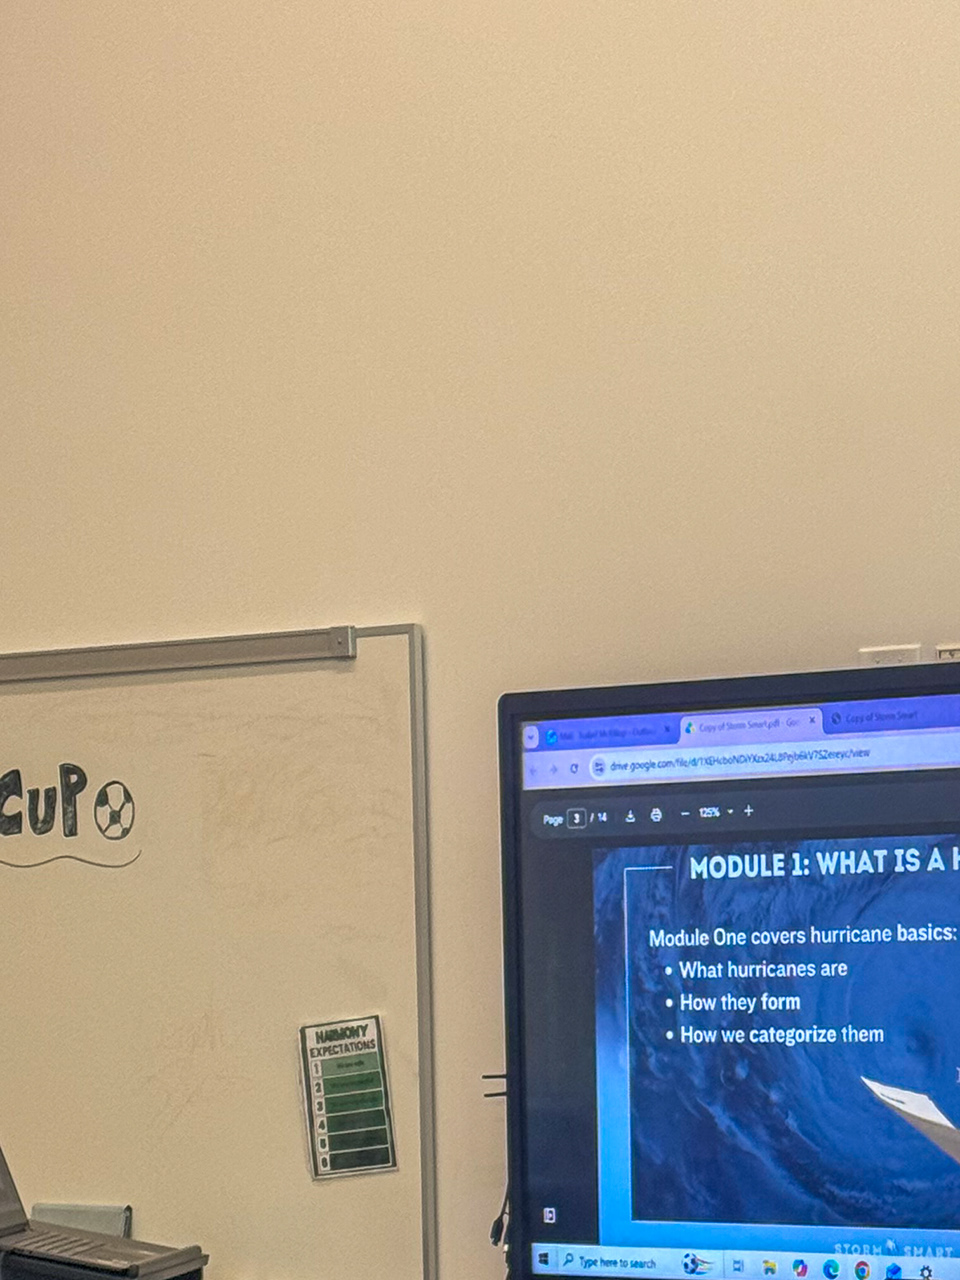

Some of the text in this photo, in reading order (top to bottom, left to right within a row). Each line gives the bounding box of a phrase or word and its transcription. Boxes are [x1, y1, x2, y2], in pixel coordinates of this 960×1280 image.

[699, 722, 716, 733] Copy
[543, 814, 564, 827] Page
[597, 811, 608, 822] 14
[699, 806, 721, 818] 125%
[690, 853, 786, 880] MODULE
[791, 852, 810, 876] 1:
[816, 849, 888, 876] WHAT
[894, 848, 921, 873] IS
[926, 847, 946, 872] A
[649, 923, 958, 947] Module One covers hurricane basics:
[679, 960, 848, 979] What hurricanes are
[680, 992, 801, 1014] How they form
[315, 1024, 369, 1044] HARMONY
[680, 1024, 884, 1047] How we categorize them
[310, 1039, 376, 1058] EXPECTATIONS
[314, 1062, 320, 1075] 1
[315, 1081, 322, 1094] 2
[316, 1101, 323, 1112] 3
[318, 1119, 326, 1131] 4
[834, 1243, 954, 1258] STORM SMART
[579, 1255, 656, 1269] Type here to search
